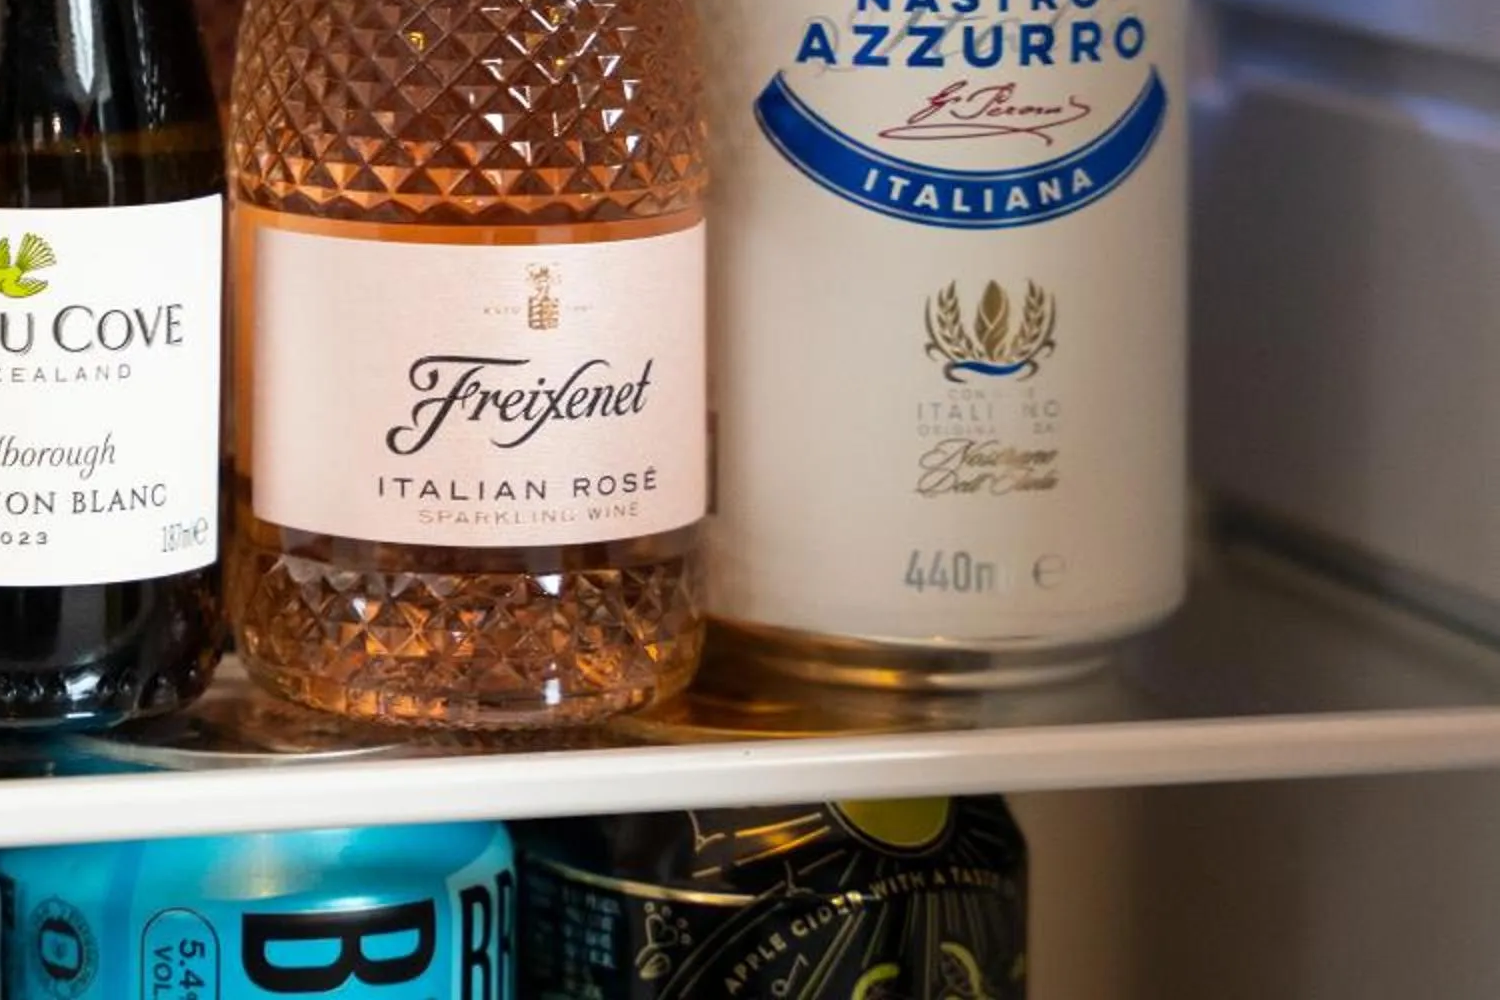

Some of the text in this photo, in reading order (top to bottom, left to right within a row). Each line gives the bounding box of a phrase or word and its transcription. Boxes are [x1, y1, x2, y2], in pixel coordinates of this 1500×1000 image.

[794, 17, 1146, 68] AZZURRO
[863, 167, 1095, 213] ITALIANA
[52, 303, 184, 354] COVE
[386, 354, 654, 456] Freixenet
[916, 399, 1061, 421] ITALINO
[72, 484, 167, 514] BLANC
[378, 466, 658, 501] ITALIAN ROSÉ
[419, 502, 640, 524] SPARKLING WINE
[724, 932, 787, 995] APPLE
[870, 871, 925, 898] WITH
[179, 938, 205, 1000] 5.4
